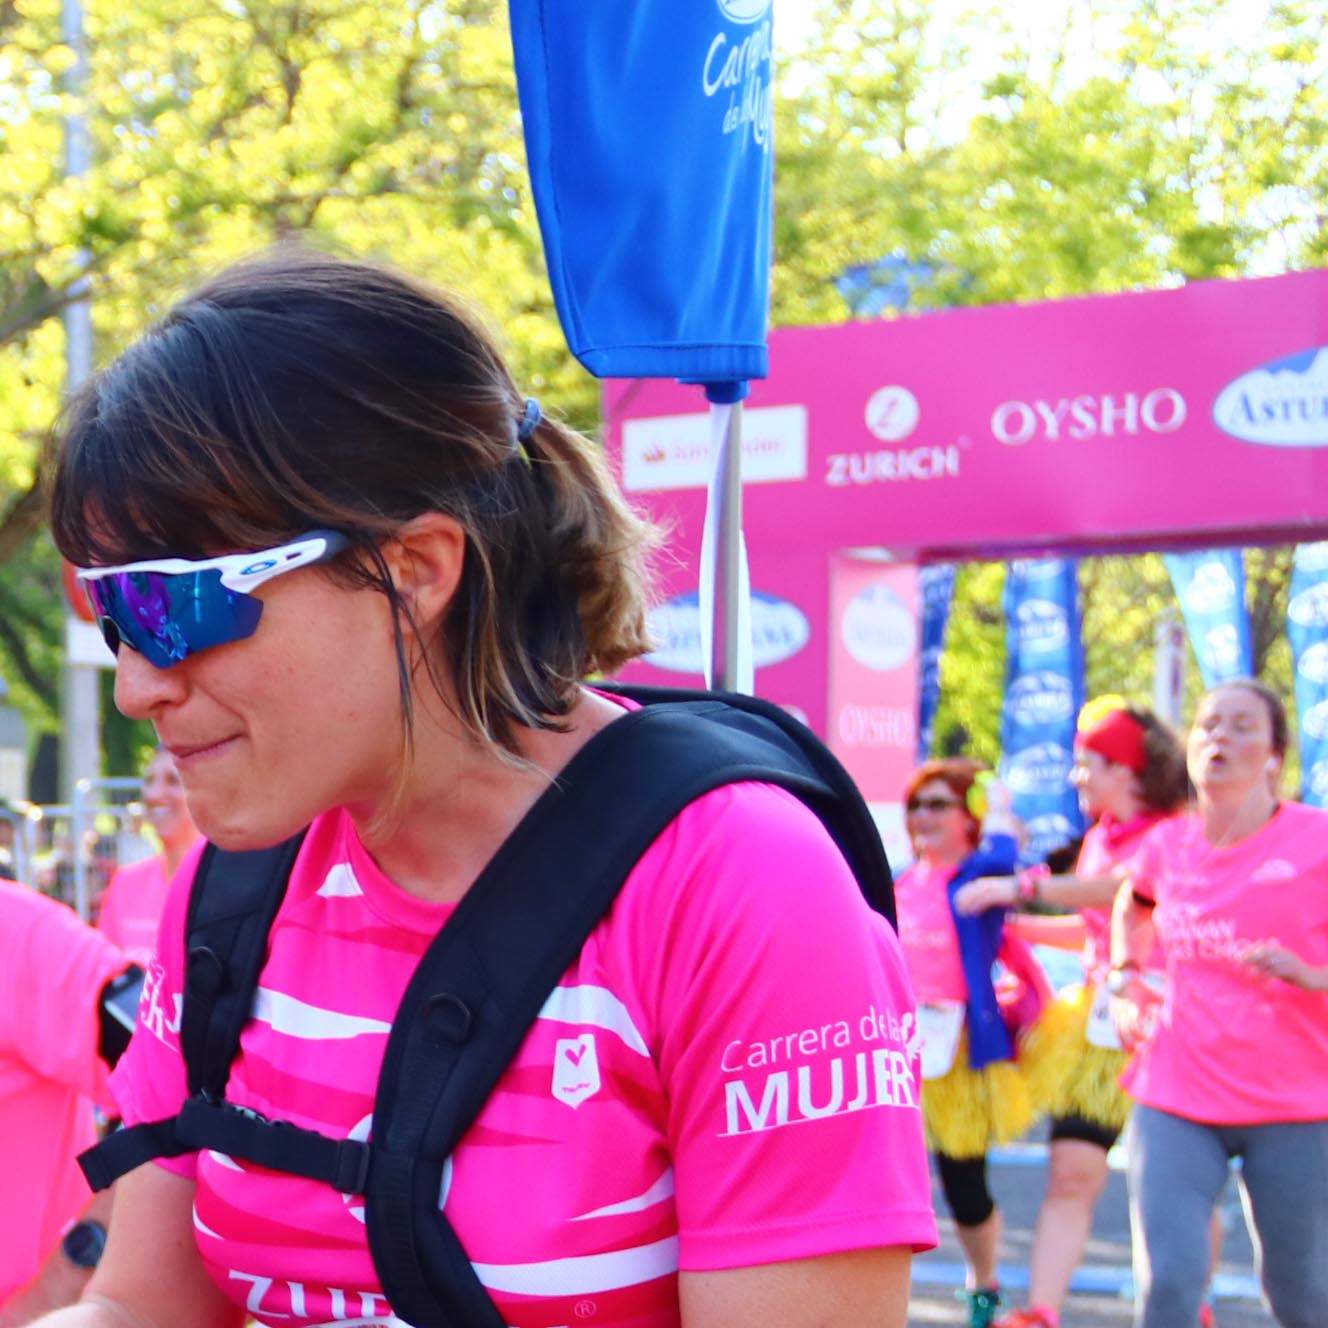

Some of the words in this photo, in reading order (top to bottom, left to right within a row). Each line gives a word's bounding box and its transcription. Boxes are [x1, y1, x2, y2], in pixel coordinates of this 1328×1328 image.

[990, 387, 1187, 446] OYSHO
[1230, 390, 1328, 424] ASTU
[825, 445, 960, 487] ZURICH
[720, 1020, 851, 1073] Carrera
[724, 1048, 915, 1136] MUJER
